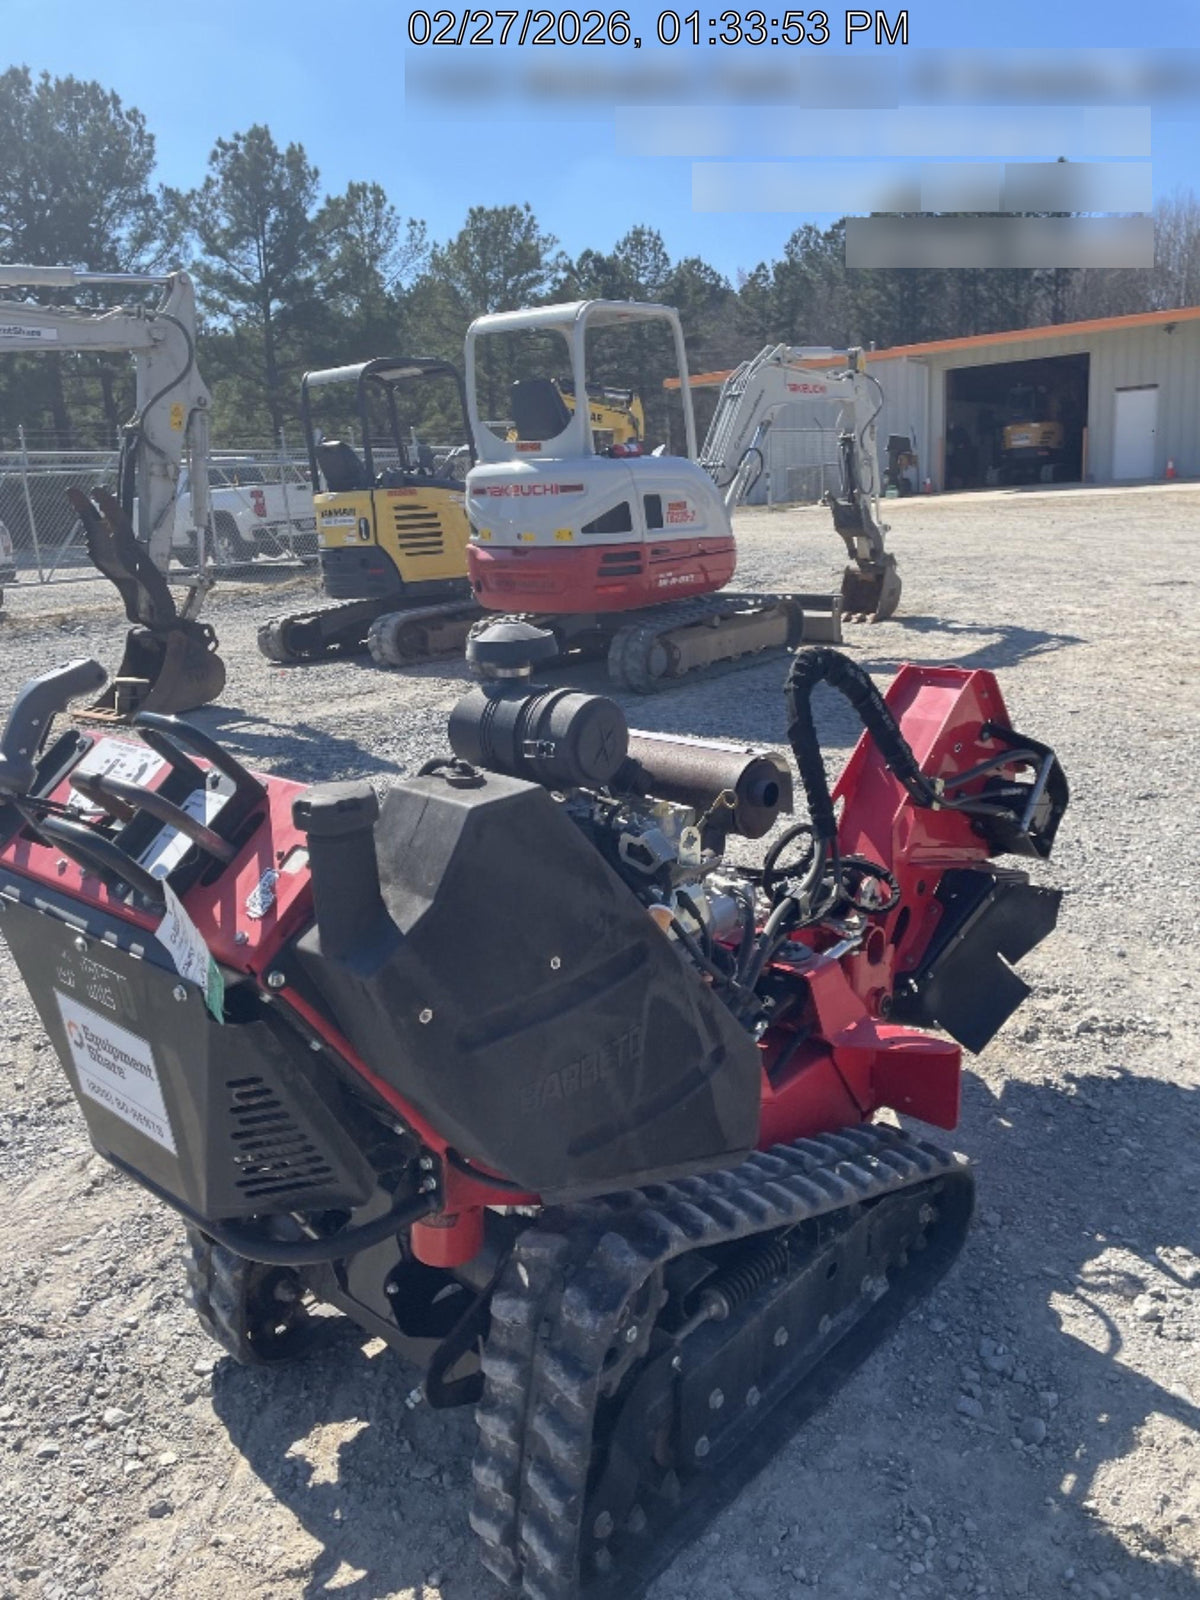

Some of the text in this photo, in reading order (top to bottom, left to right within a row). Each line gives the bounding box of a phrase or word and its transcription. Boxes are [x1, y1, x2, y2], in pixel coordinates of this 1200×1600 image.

[486, 483, 560, 497] TAKEUCHI
[80, 1023, 155, 1081] Equipment
[86, 1044, 127, 1080] Share
